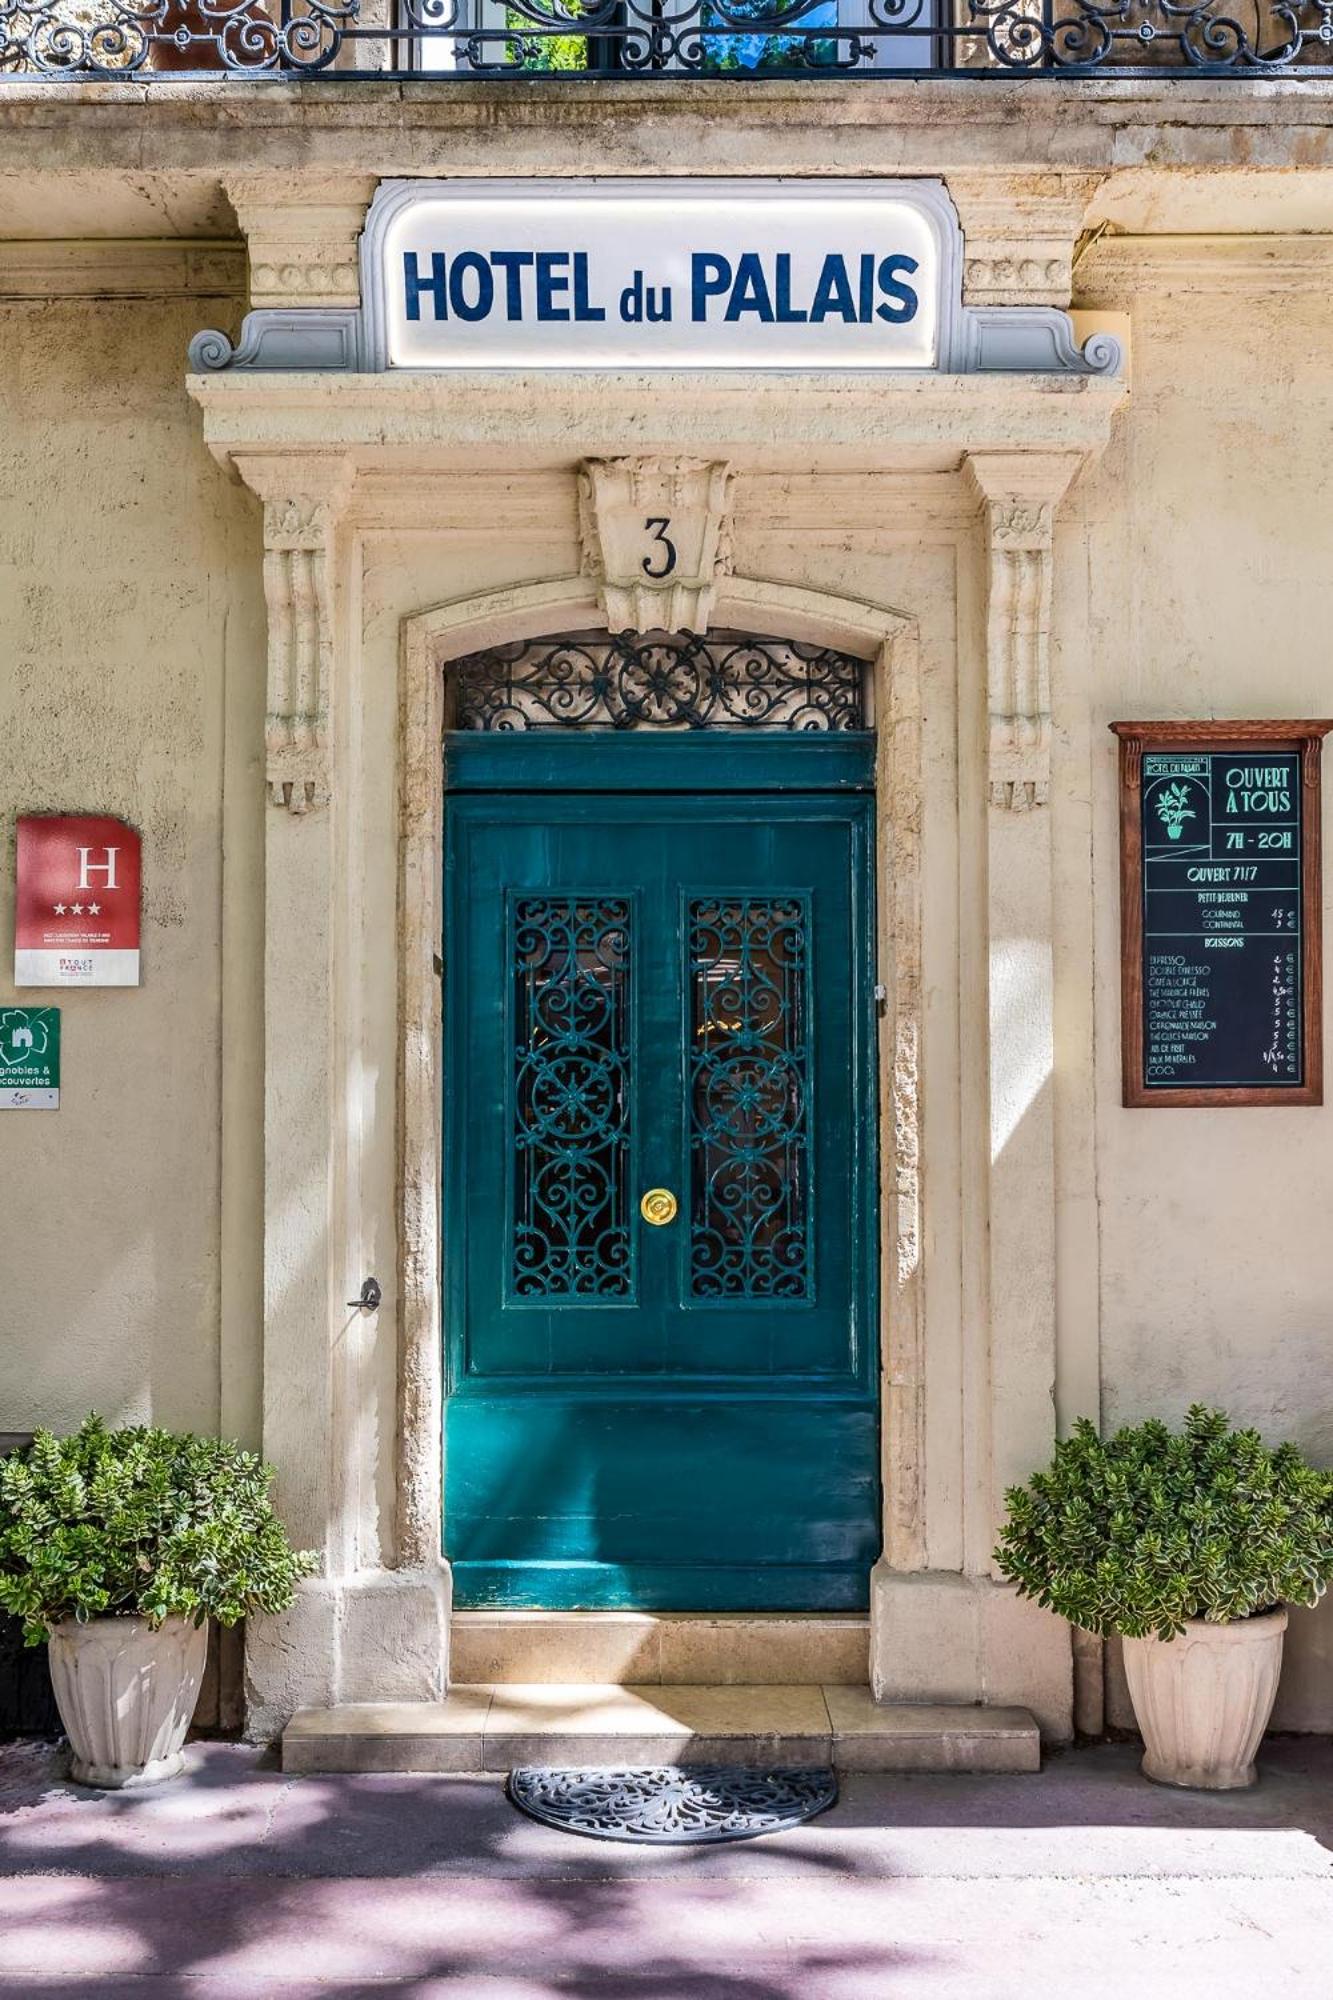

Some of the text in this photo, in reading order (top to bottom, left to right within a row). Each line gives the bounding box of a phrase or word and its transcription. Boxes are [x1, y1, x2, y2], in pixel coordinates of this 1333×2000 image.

[404, 251, 919, 324] HOTEL du PALAIS
[642, 518, 676, 578] 3
[1226, 768, 1290, 788] OUVERT
[1241, 791, 1291, 812] TOUS
[1226, 832, 1244, 849] 7H
[1258, 832, 1292, 848] 20H
[75, 847, 121, 889] H
[1187, 867, 1231, 882] OUVERT
[1204, 938, 1245, 948] BOISSONS
[43, 1066, 50, 1075] &
[0, 1077, 51, 1085] couvertes
